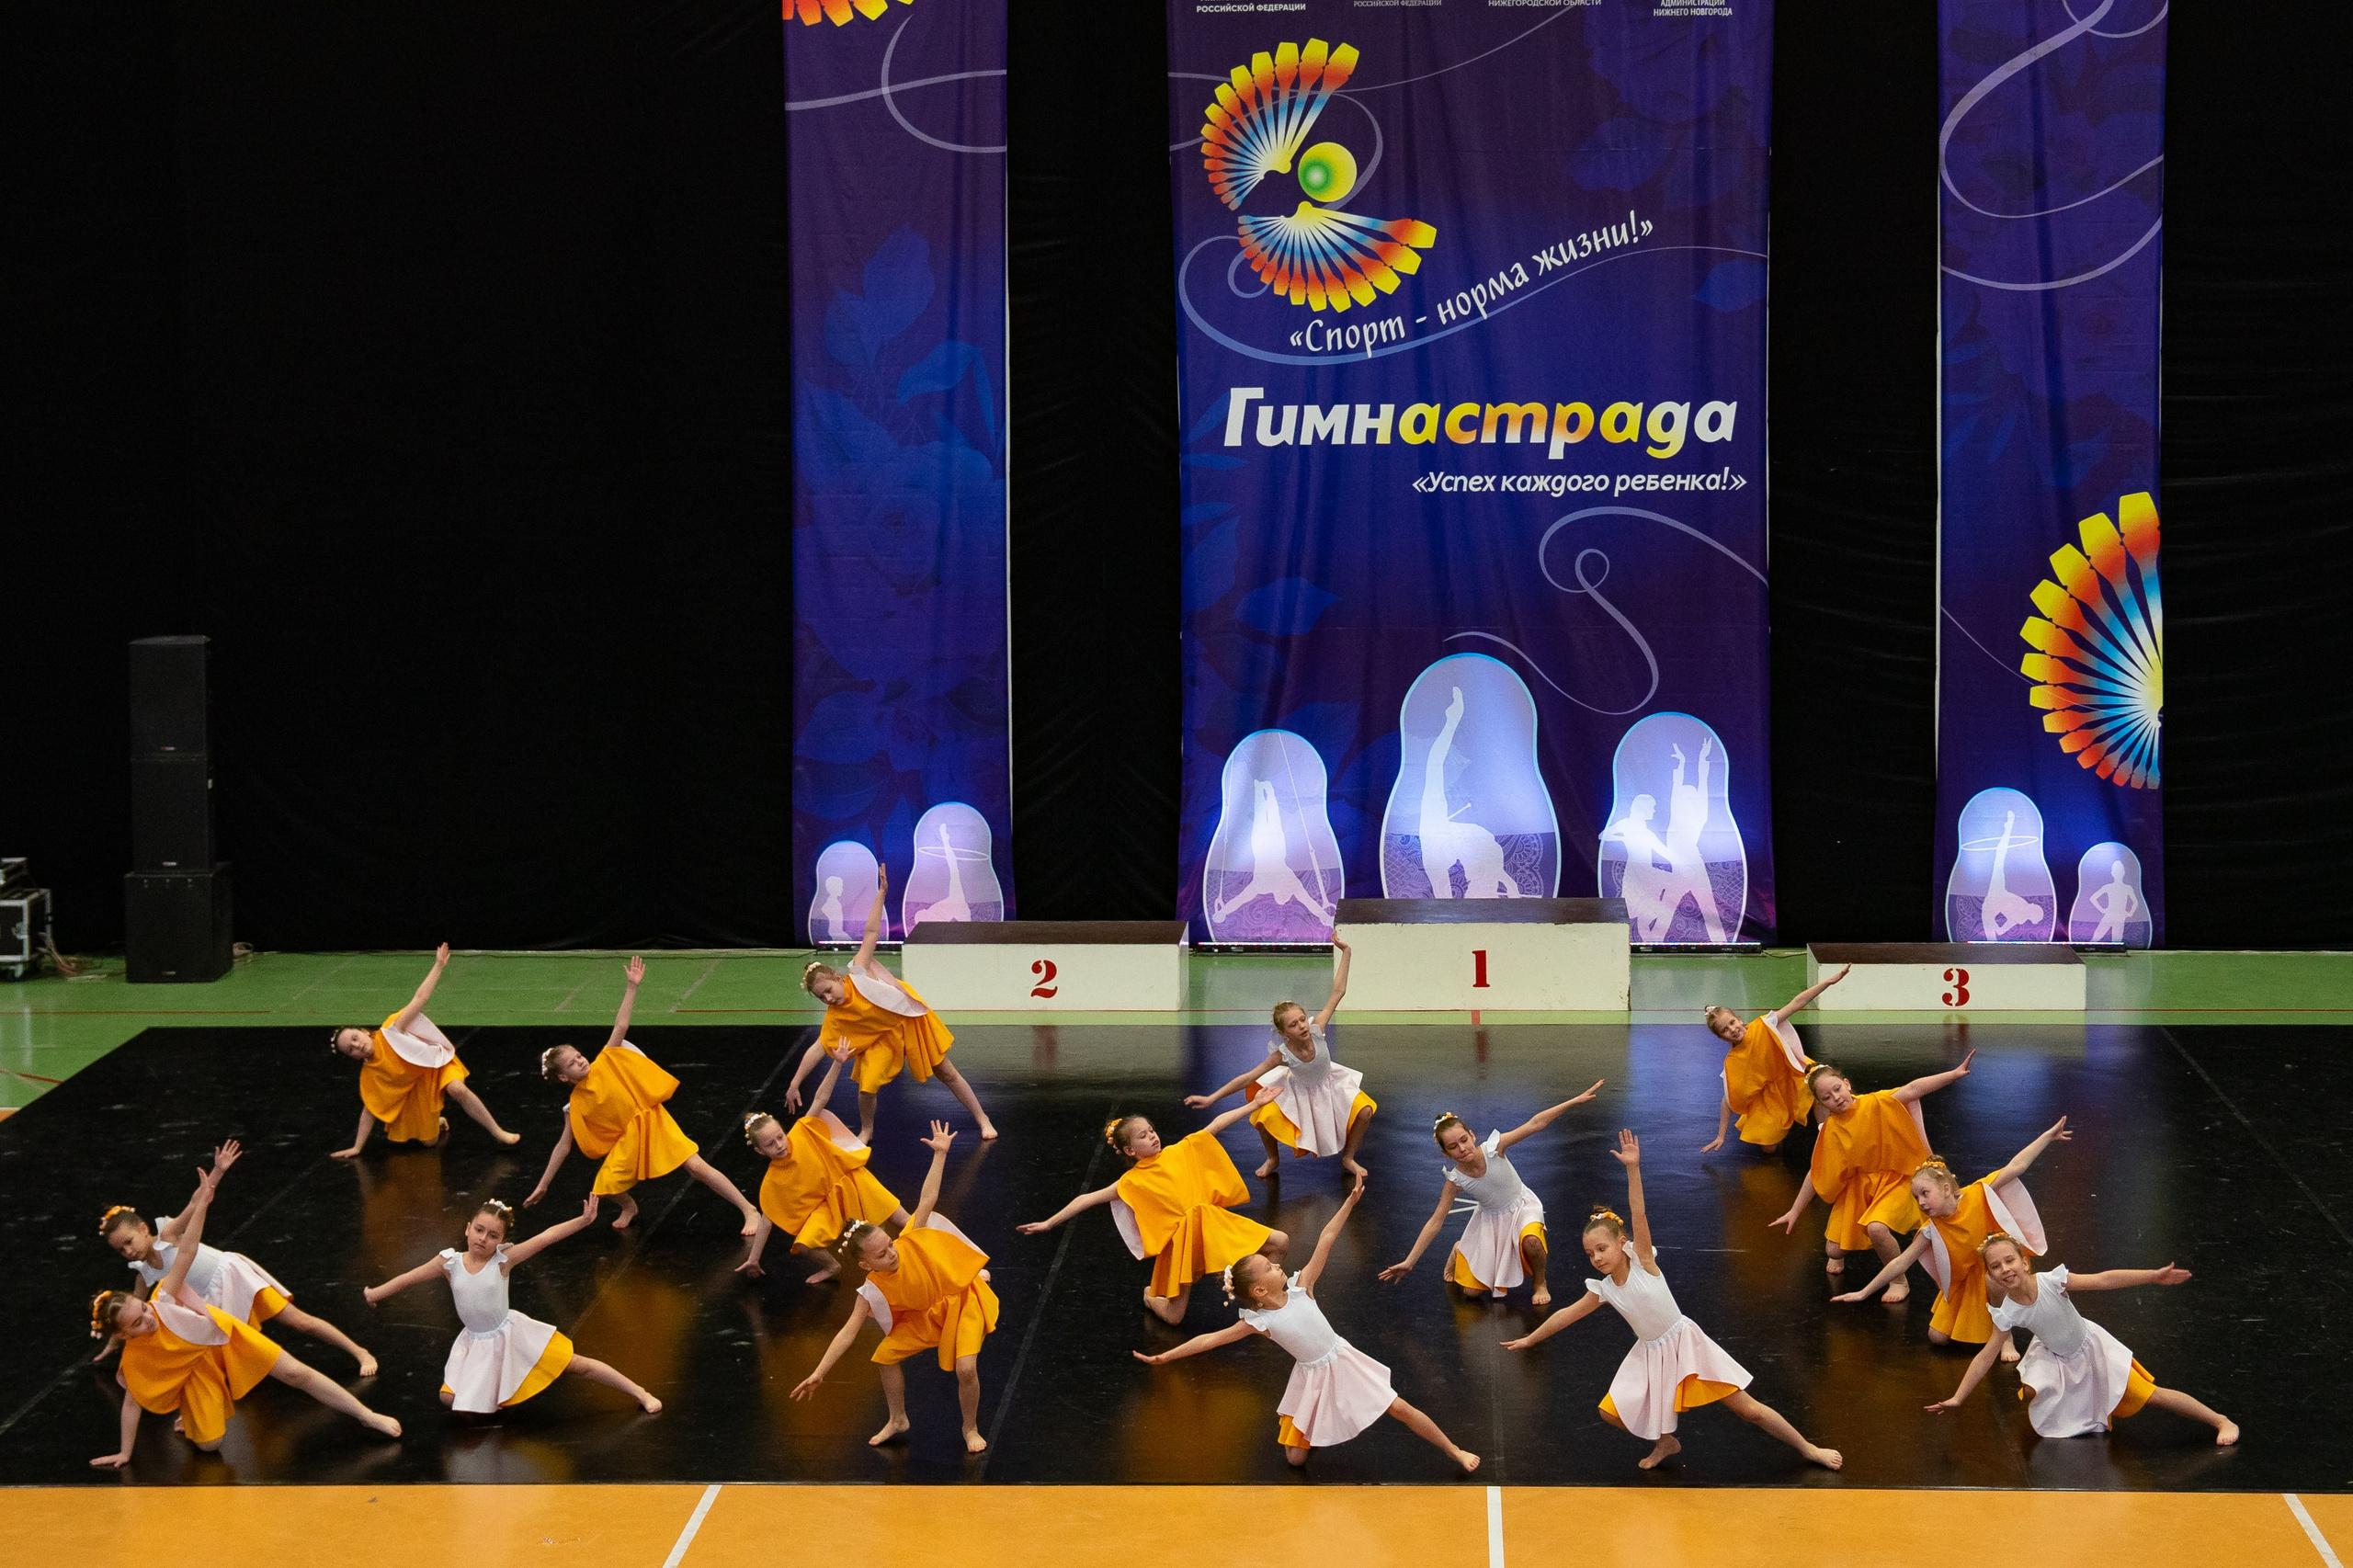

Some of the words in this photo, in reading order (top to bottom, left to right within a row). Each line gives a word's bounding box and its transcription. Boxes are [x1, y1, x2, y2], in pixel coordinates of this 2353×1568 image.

[1196, 4, 1255, 13] РОССИЙСКОЙ
[1256, 4, 1306, 12] ФЕДЕРАЦИИ
[1653, 8, 1689, 17] НИЖНЕГО
[1690, 7, 1733, 17] НОВГОРОДА
[1290, 315, 1406, 358] «Спорт
[1437, 261, 1529, 324] норма
[1531, 210, 1654, 277] жизни!»
[1222, 386, 1739, 460] Гимнастрада
[1412, 472, 1496, 493] «Успех
[1501, 473, 1609, 497] каждого
[1030, 960, 1058, 999] 2
[1472, 949, 1491, 988] 1
[1941, 968, 1970, 1006] 3
